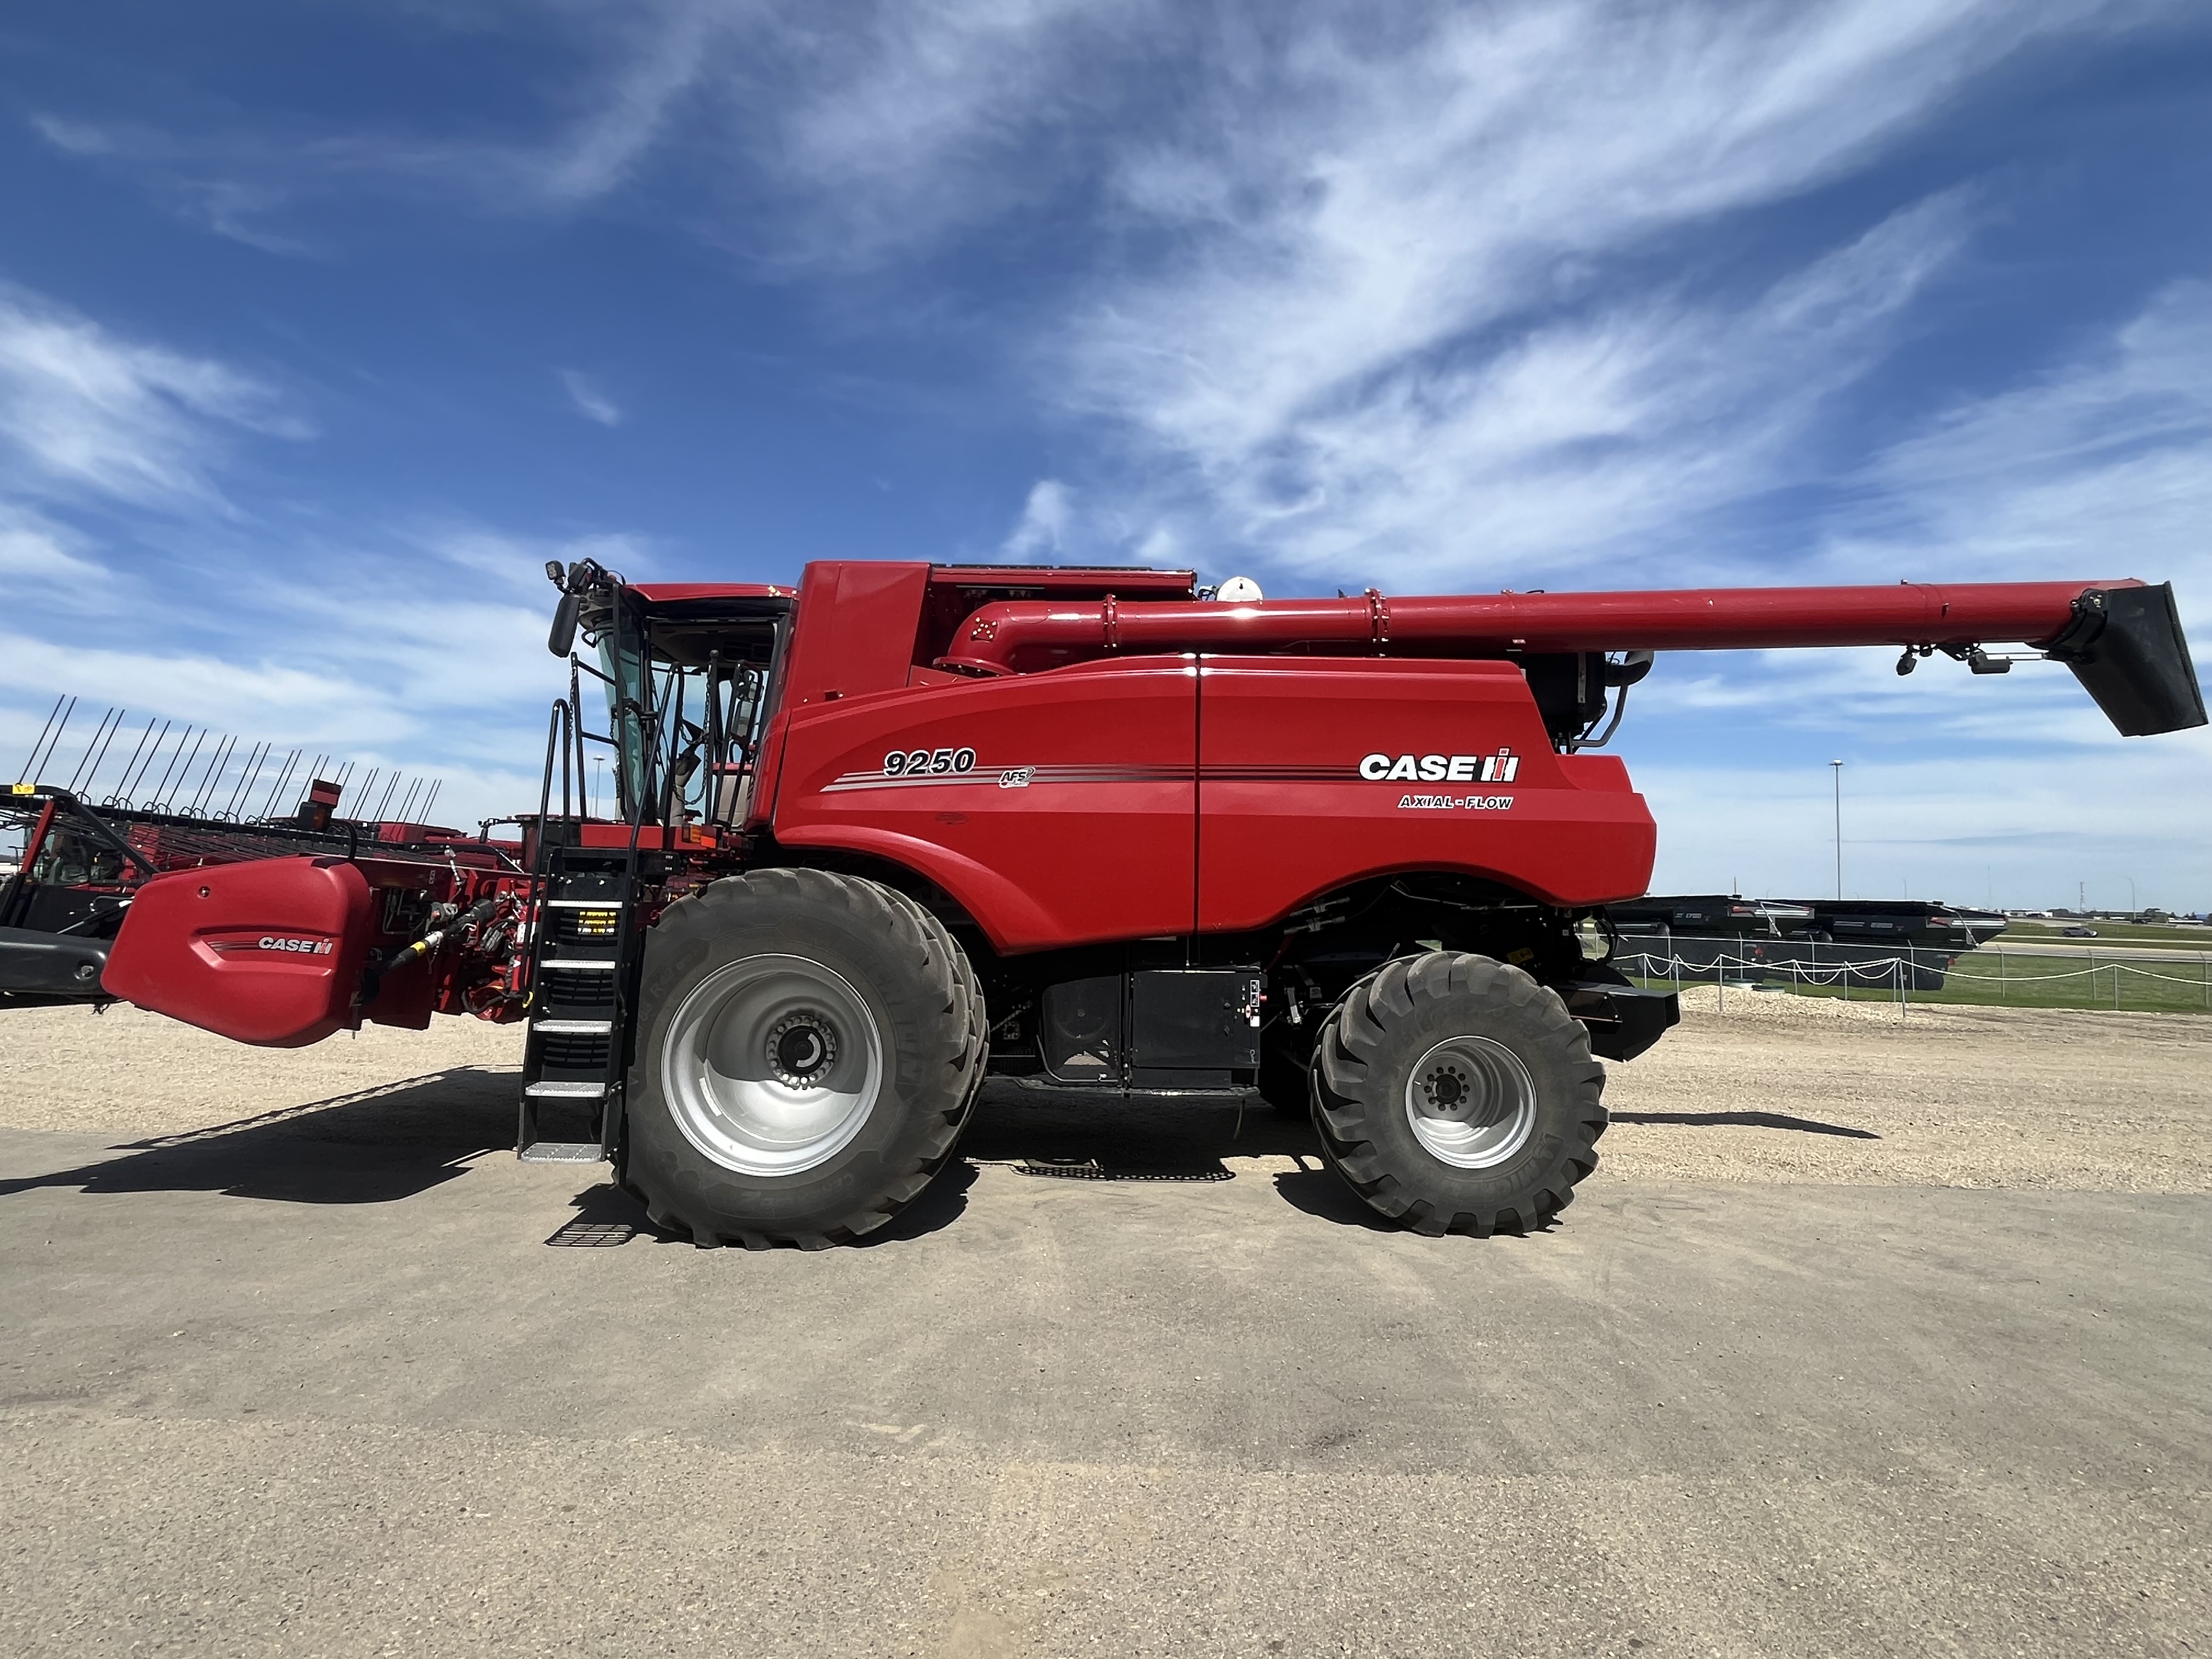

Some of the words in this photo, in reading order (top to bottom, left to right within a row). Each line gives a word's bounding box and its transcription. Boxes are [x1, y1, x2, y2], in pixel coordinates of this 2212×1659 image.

[884, 748, 976, 776] 9250
[1359, 753, 1479, 781] CASE
[999, 770, 1027, 782] AFS
[1398, 795, 1514, 809] AXIAL-FLOW
[258, 936, 313, 952] CASE
